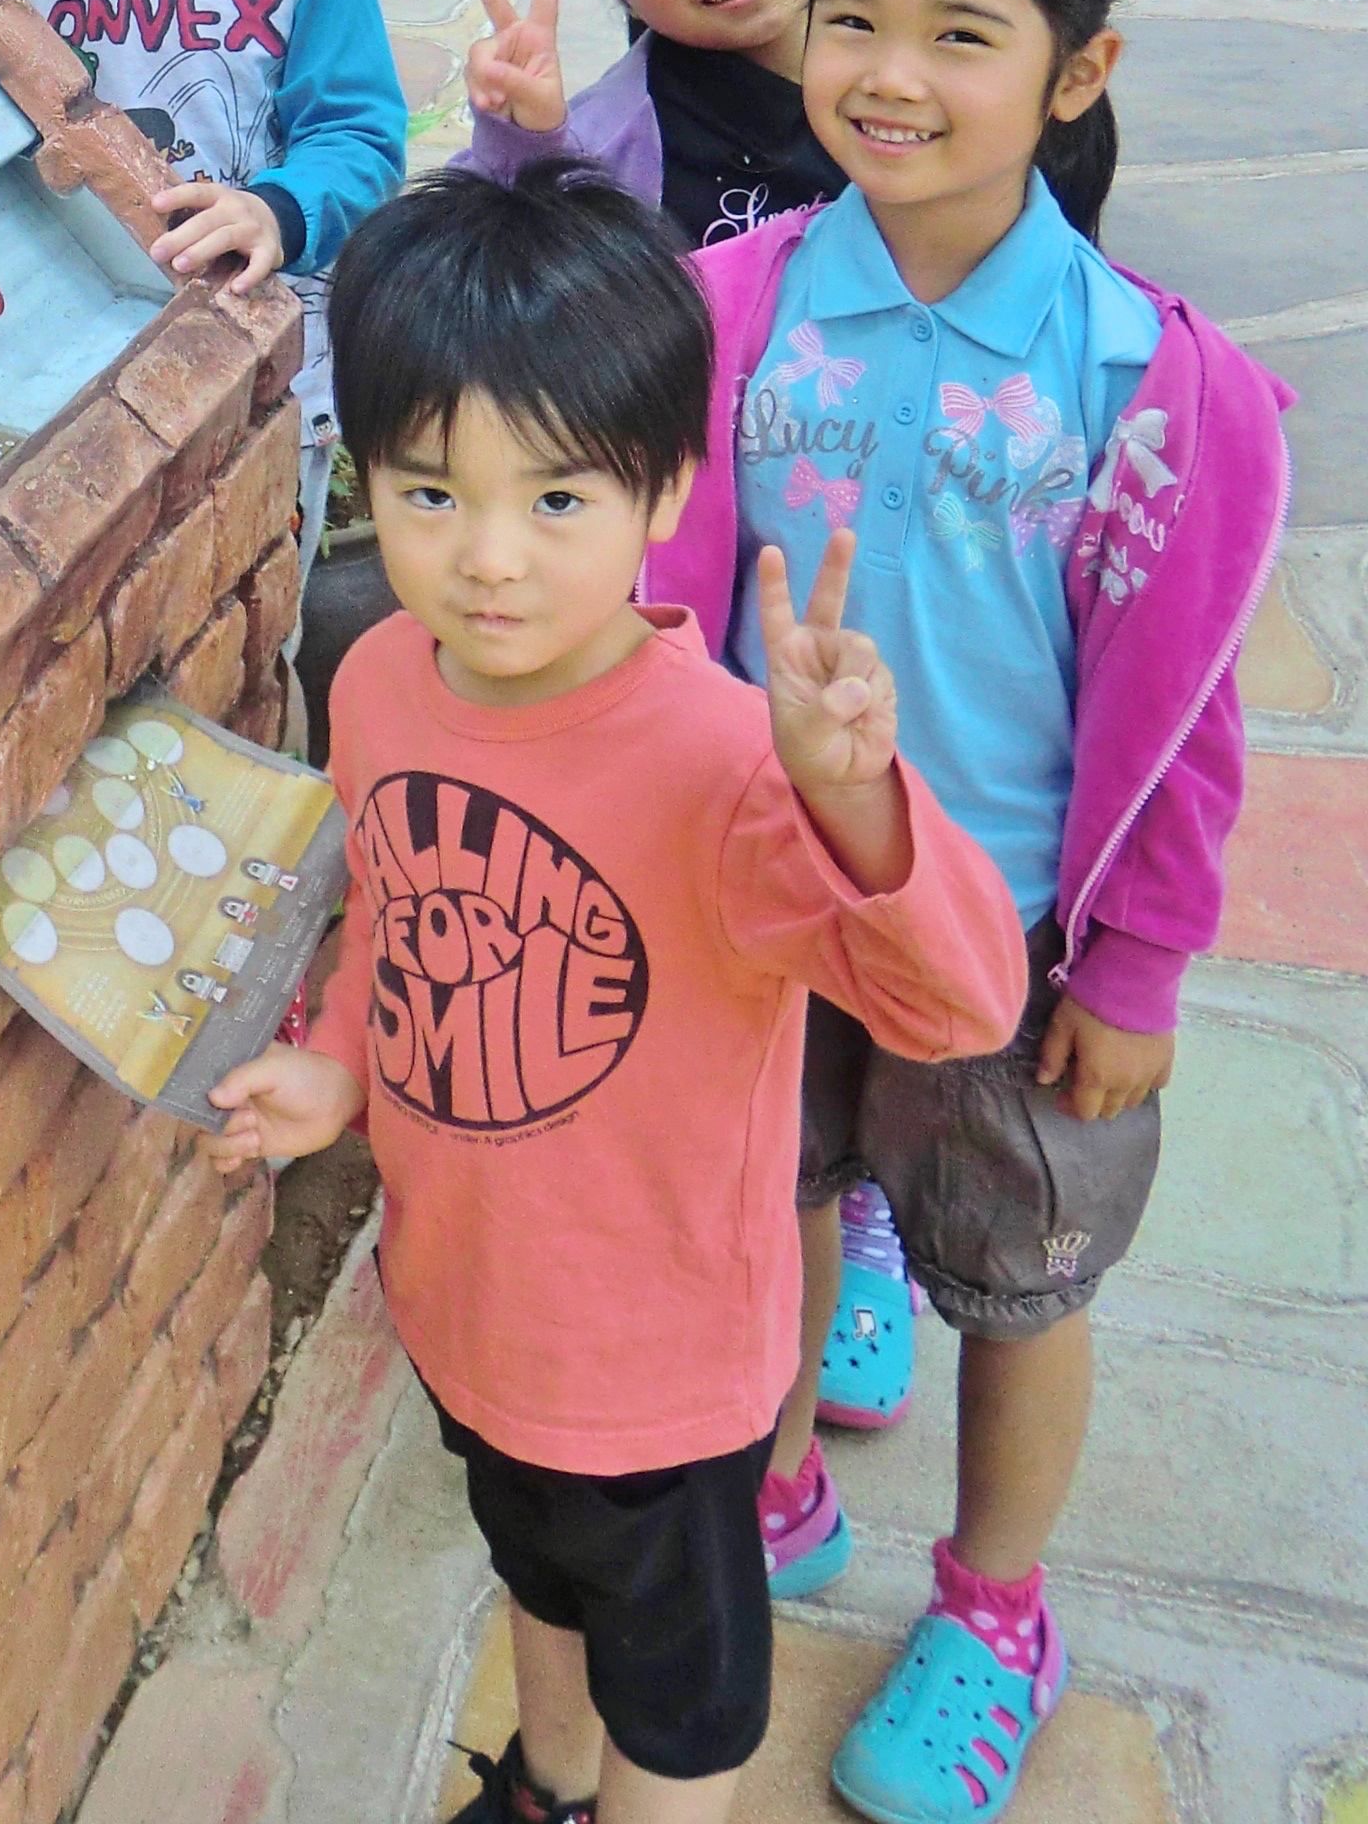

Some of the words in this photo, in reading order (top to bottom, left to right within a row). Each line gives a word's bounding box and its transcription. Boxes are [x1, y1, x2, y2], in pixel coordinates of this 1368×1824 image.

[741, 388, 879, 479] Lucy
[355, 778, 628, 957] ALLING
[384, 889, 524, 984] FOR
[374, 928, 635, 1122] SMILE
